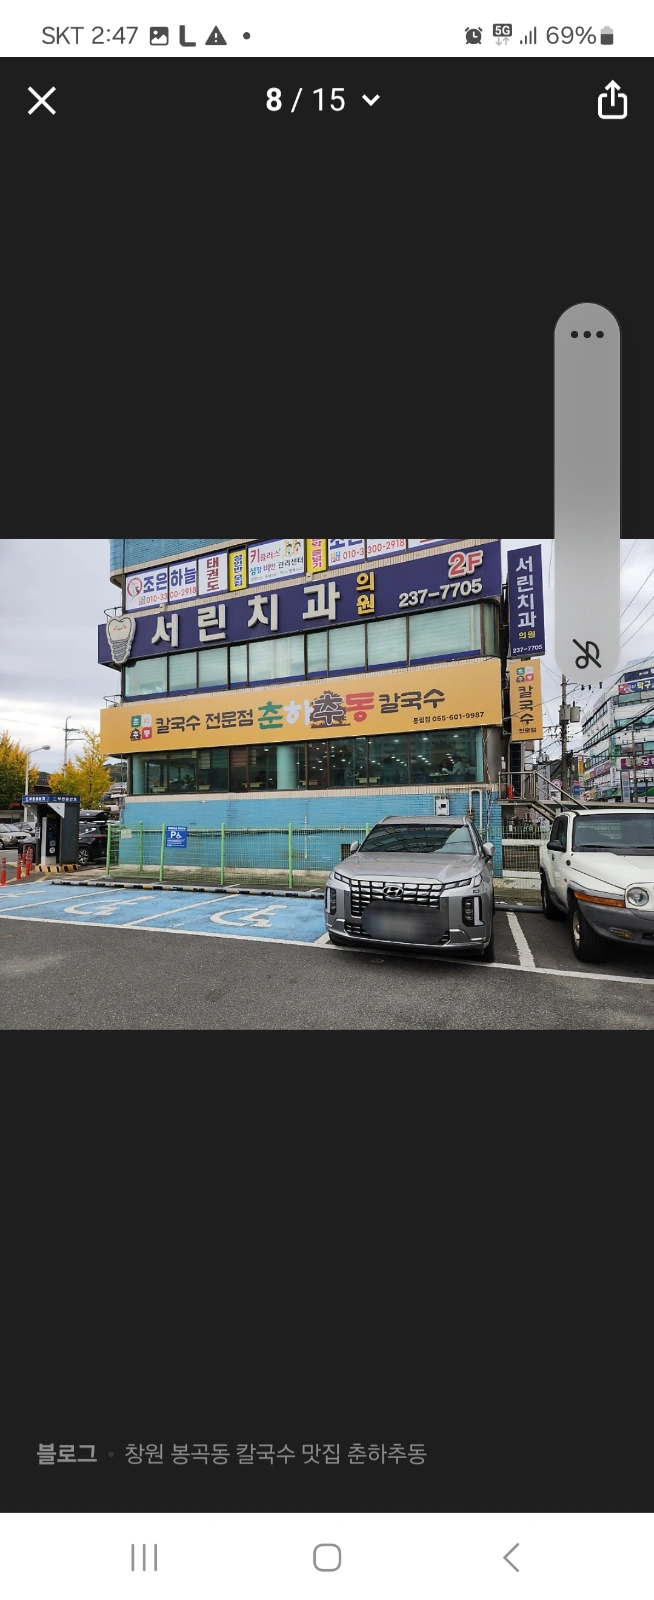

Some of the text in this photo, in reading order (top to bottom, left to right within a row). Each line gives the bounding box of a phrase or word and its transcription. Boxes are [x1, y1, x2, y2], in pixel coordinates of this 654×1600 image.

[277, 556, 304, 569] 관리센터
[343, 539, 405, 560] 010-3300-2918
[447, 549, 484, 580] 2F
[206, 556, 220, 592] 태권도
[398, 578, 483, 608] 237-7705
[515, 555, 537, 628] 서린치과
[151, 571, 375, 648] 서린치과 의원
[512, 643, 543, 654] 237-7705
[518, 630, 536, 639] 의원
[156, 714, 201, 735] 칼국수
[205, 709, 254, 730] 전문점
[379, 688, 446, 714] 칼국수
[432, 711, 485, 722] 055-601-9987
[518, 685, 534, 725] 칼국수
